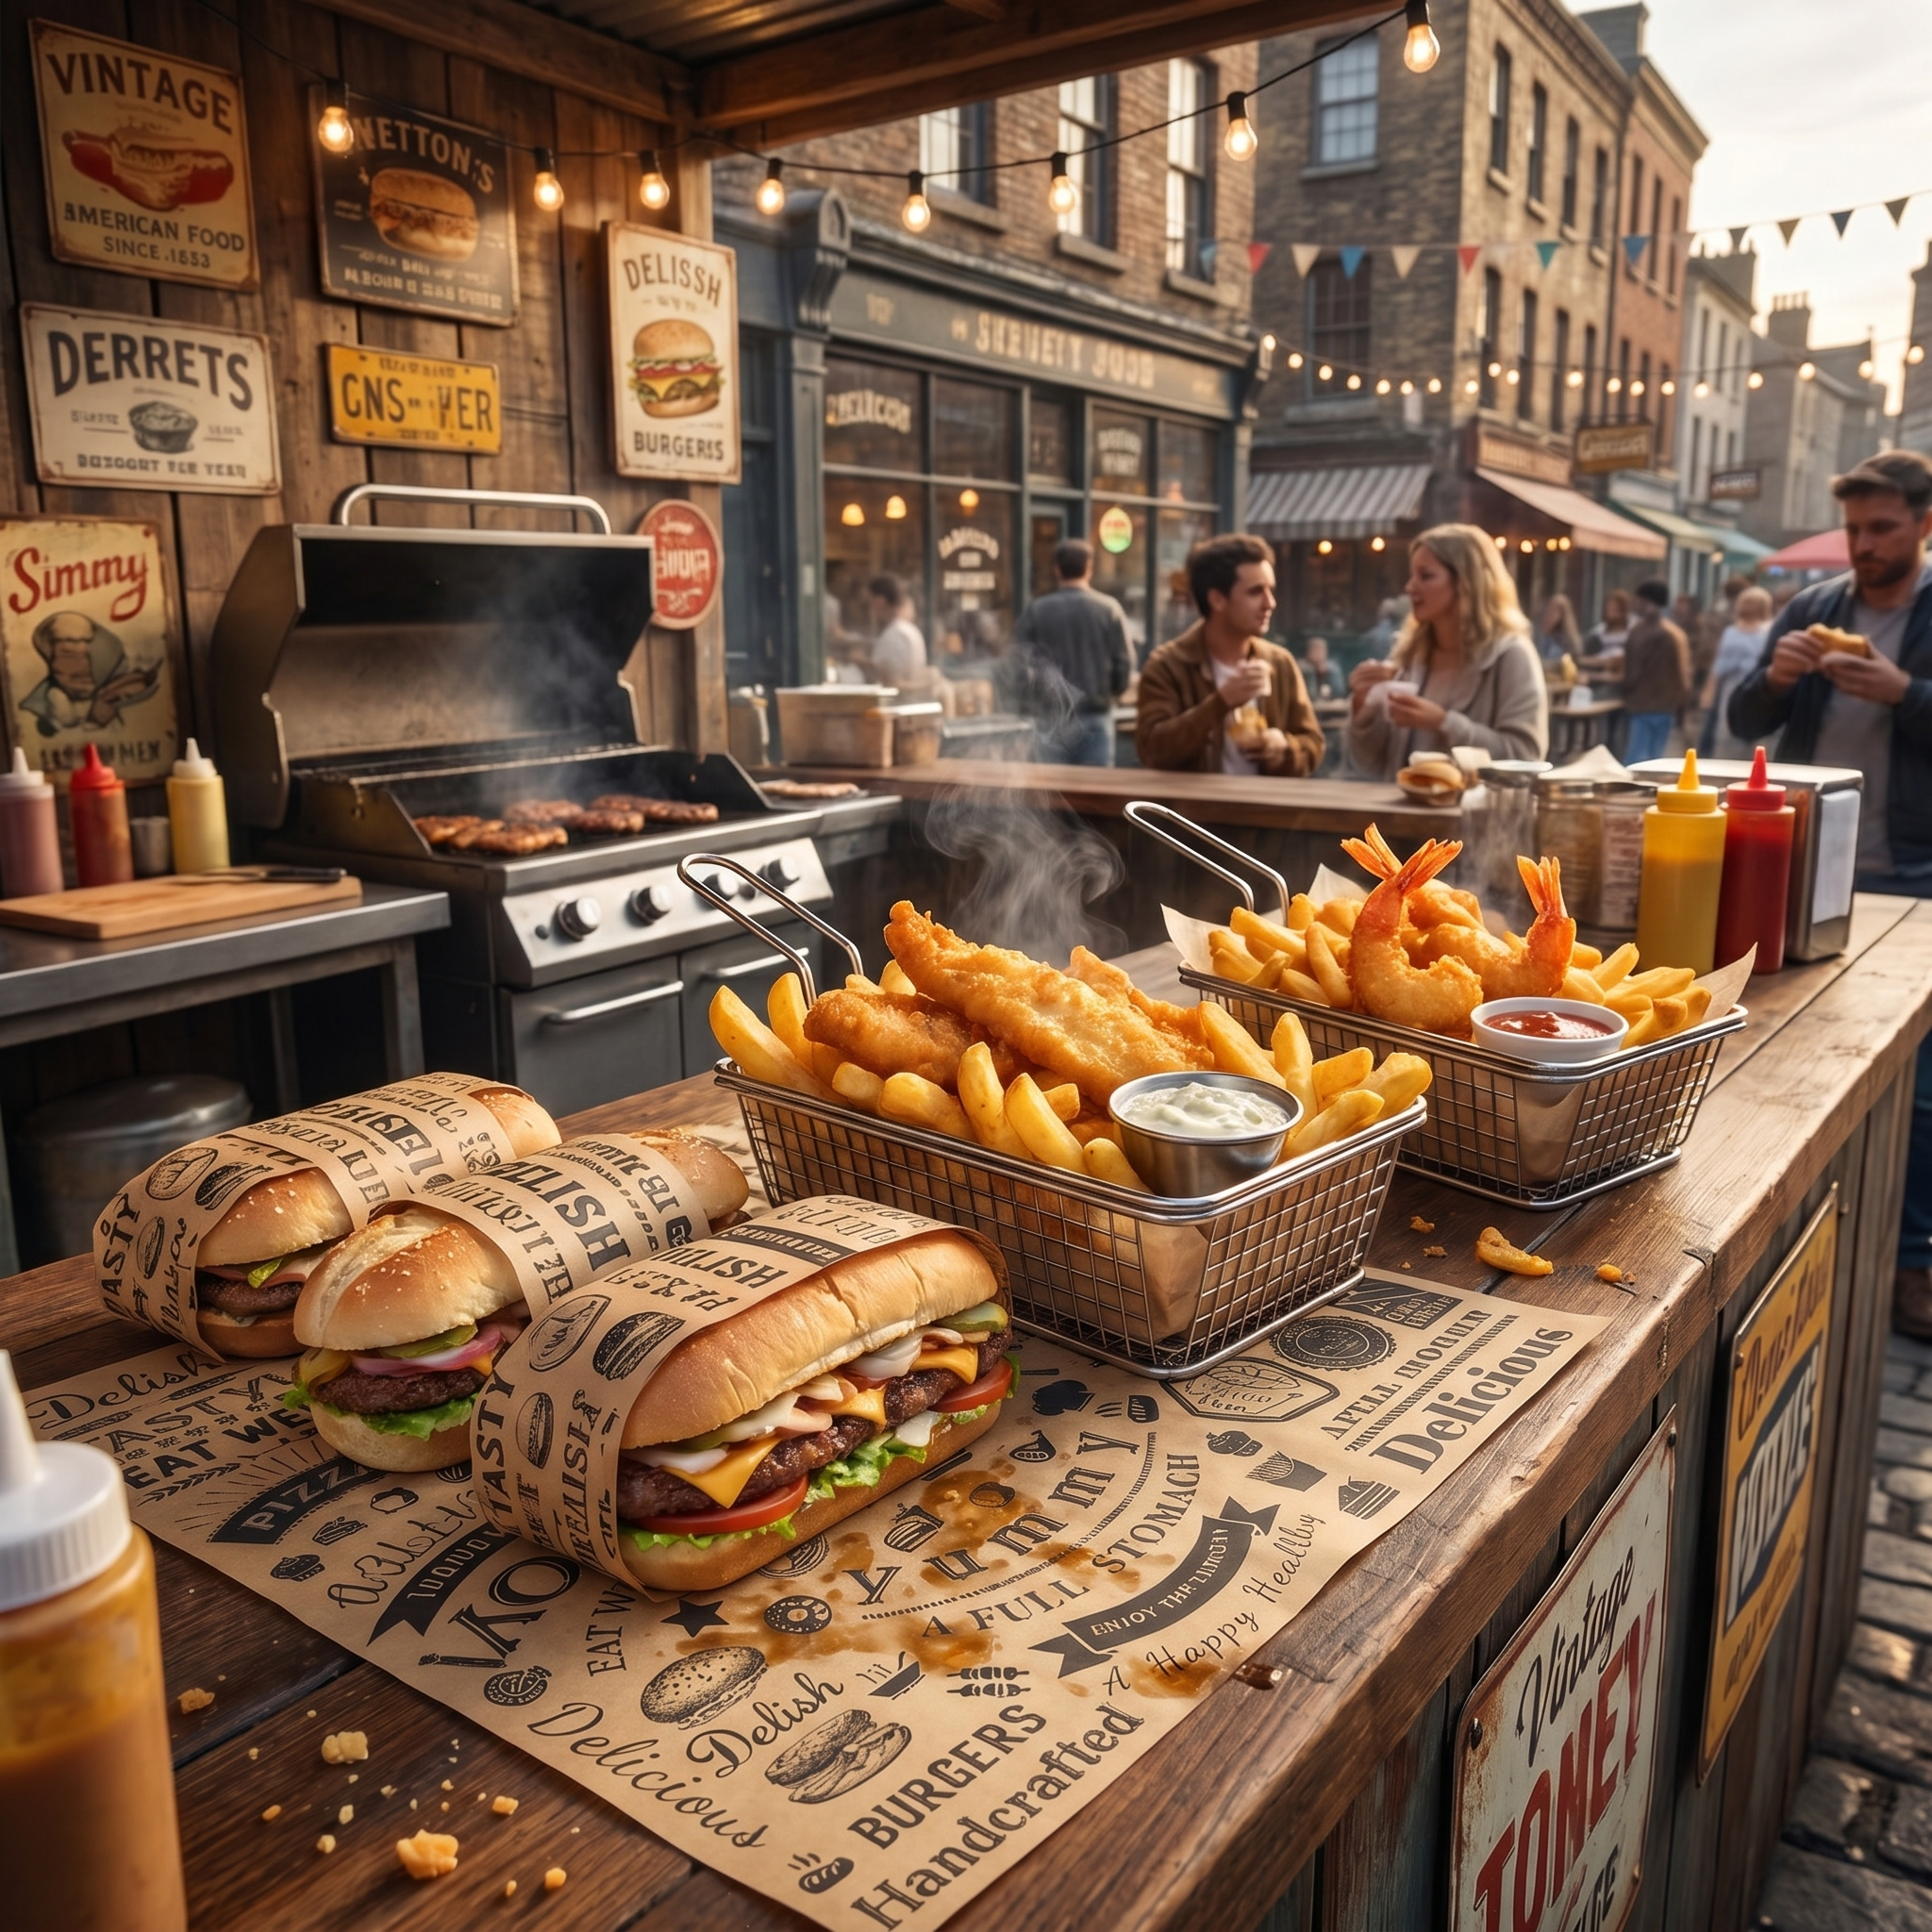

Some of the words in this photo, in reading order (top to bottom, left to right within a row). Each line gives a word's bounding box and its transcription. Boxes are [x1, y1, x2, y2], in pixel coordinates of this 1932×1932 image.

[46, 53, 233, 135] VINTAGE
[64, 202, 179, 240] AMERICAN
[187, 224, 245, 252] FOOD
[104, 236, 160, 260] SINCE
[623, 253, 722, 308] DELISSH
[49, 331, 253, 411] DERRETS
[8, 547, 148, 622] Simmy
[82, 1376, 265, 1455] ASTY
[1369, 1326, 1573, 1475] Delicious
[122, 1439, 217, 1490] EAT
[222, 1404, 313, 1444] WE
[922, 1616, 953, 1638] A
[966, 1579, 1090, 1631] FULL
[1091, 1453, 1200, 1574] STOMACH
[585, 1625, 626, 1677] EAT
[1102, 1665, 1131, 1696] A
[1145, 1609, 1259, 1678] Happy
[1516, 1545, 1633, 1768] Vintage
[686, 1672, 844, 1778] Delish
[1473, 1588, 1657, 1932] TONEY
[527, 1702, 769, 1849] Delicious
[847, 1704, 1047, 1850] BURGERS
[849, 1701, 1145, 1932] Handcrafted
